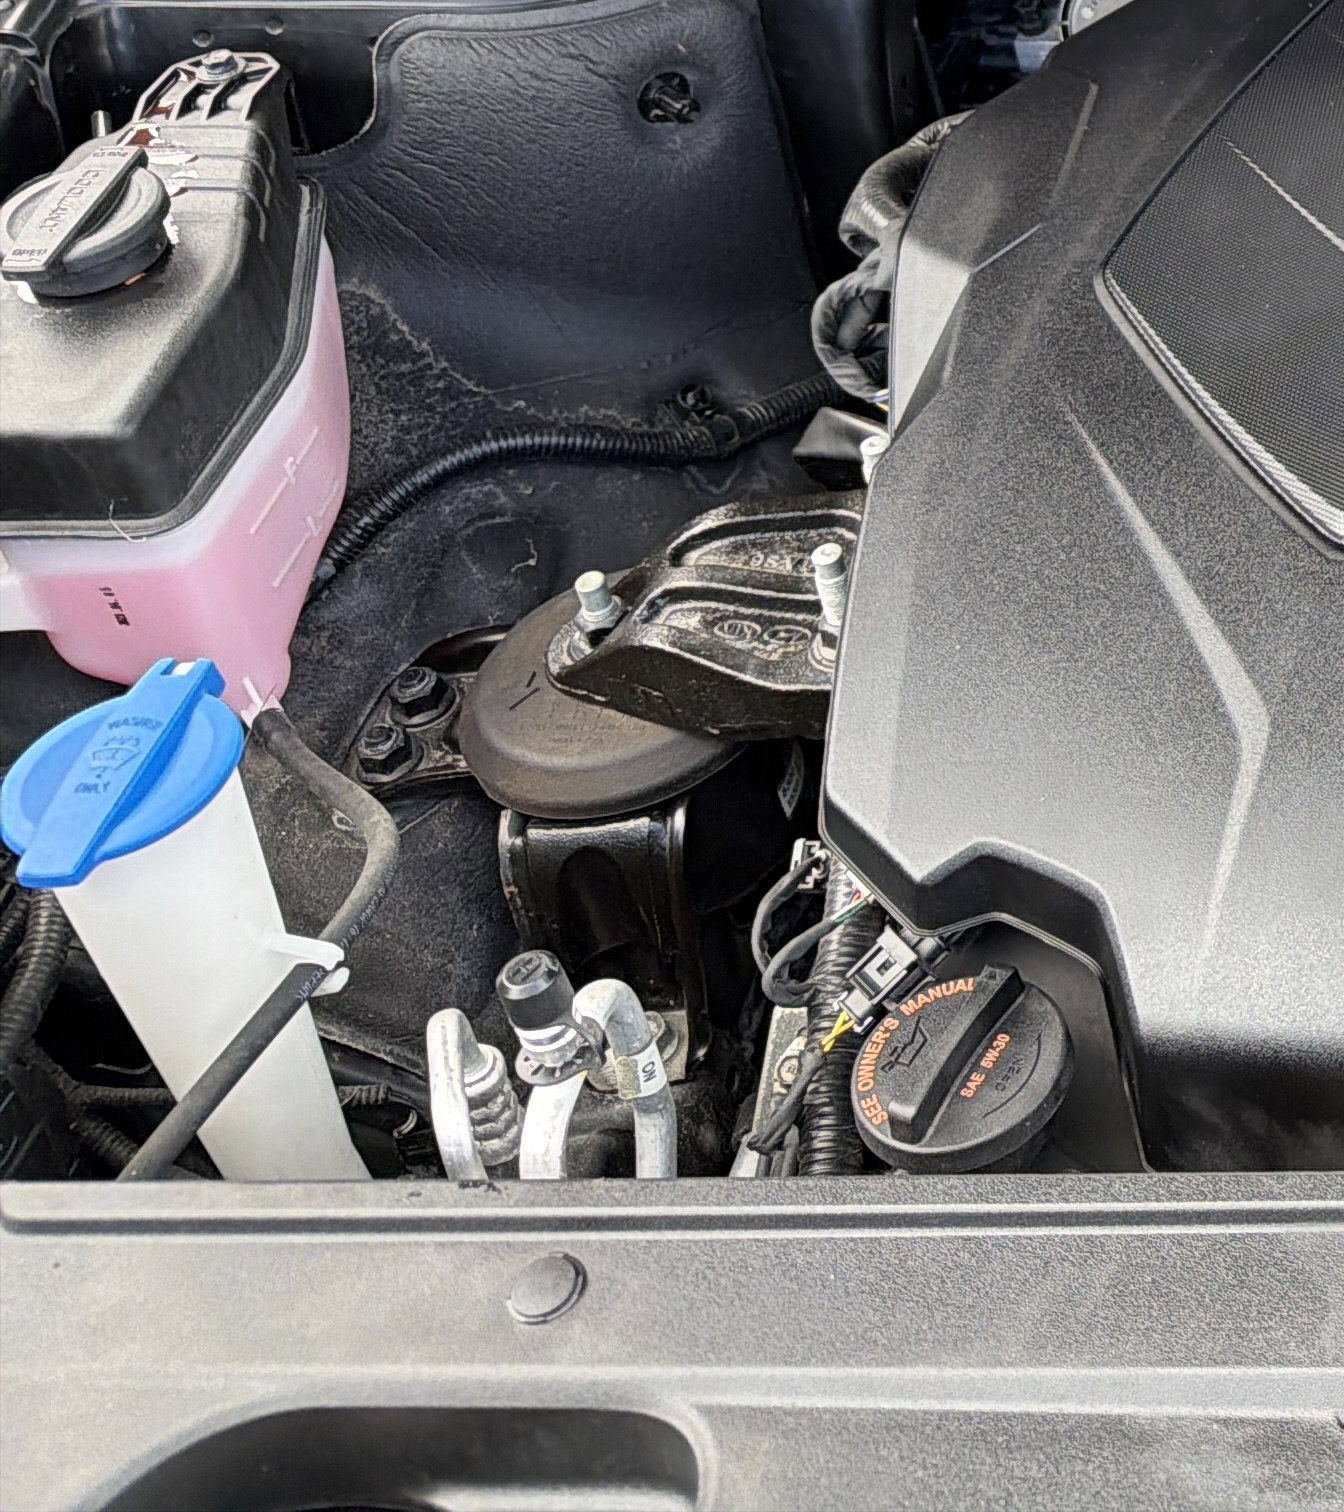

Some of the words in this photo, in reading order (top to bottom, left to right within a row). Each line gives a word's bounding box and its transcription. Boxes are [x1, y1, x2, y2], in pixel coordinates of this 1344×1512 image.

[899, 977, 976, 1017] MANUAL
[857, 1017, 901, 1092] OWNER'S
[959, 1072, 986, 1099] SAE
[980, 1033, 1011, 1070] 5W-30
[859, 1093, 889, 1126] SEE
